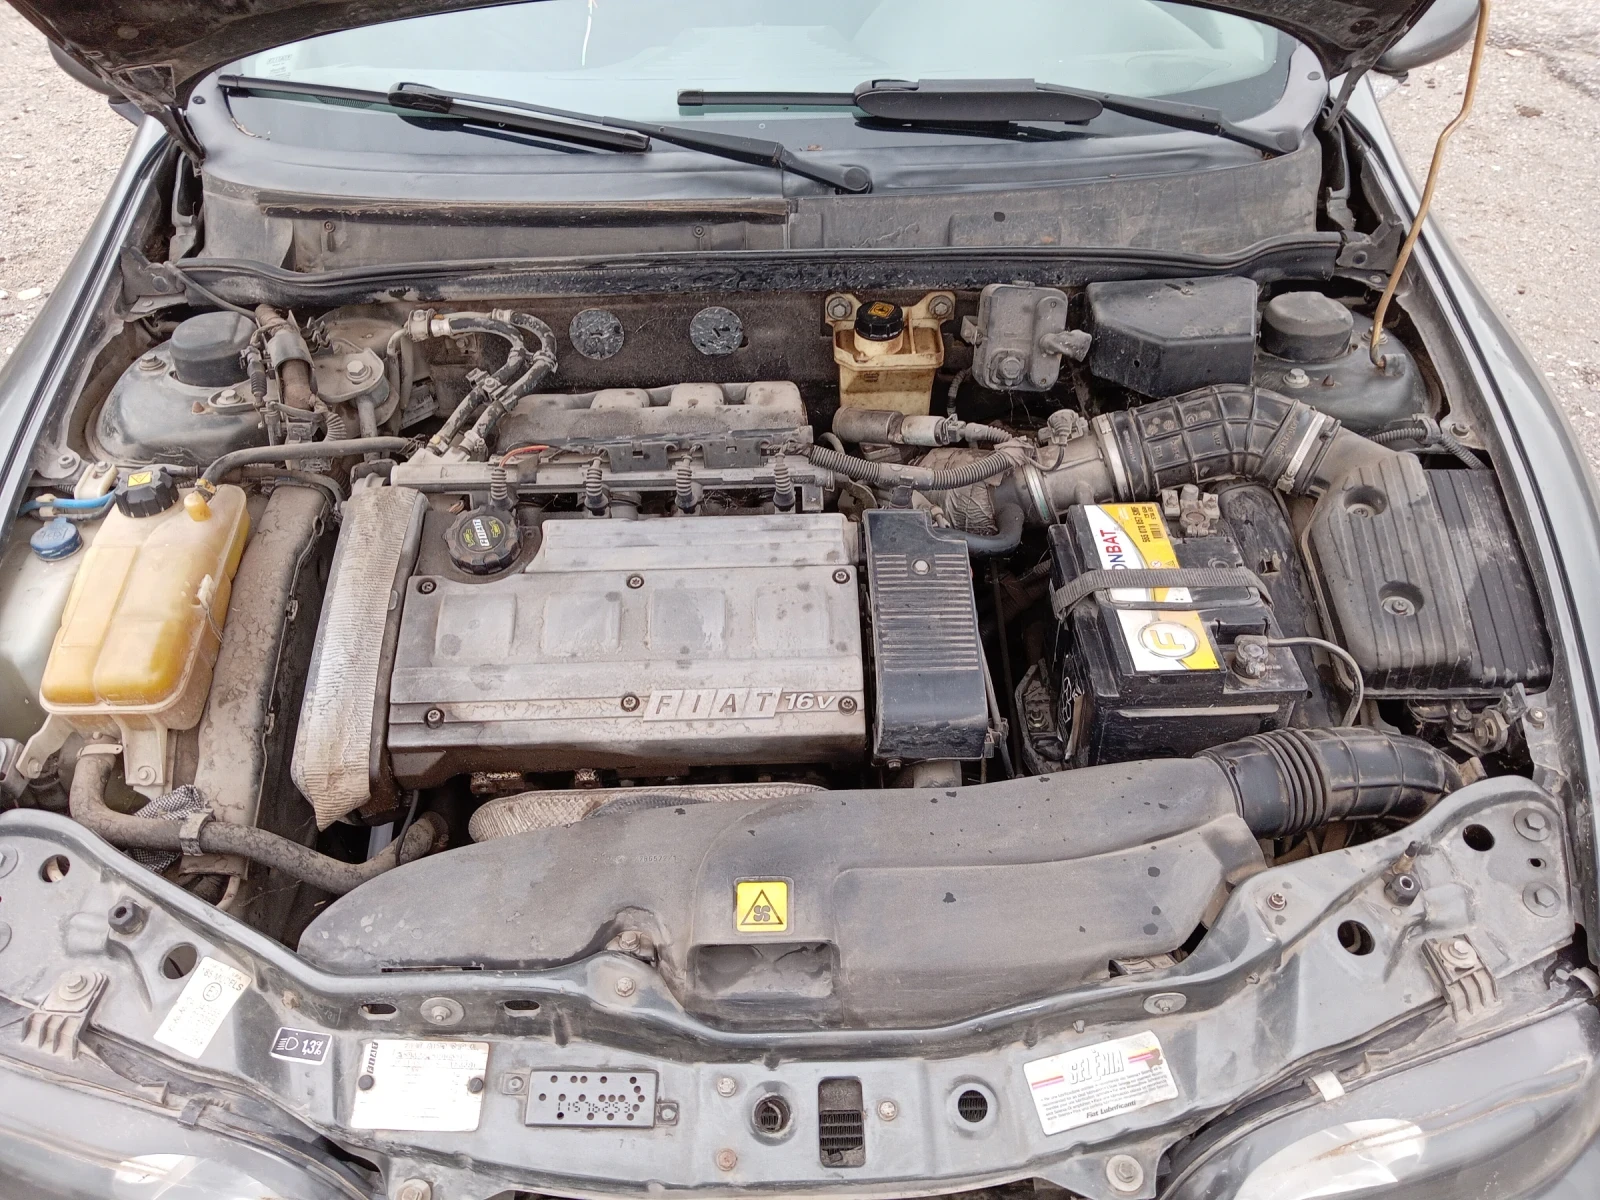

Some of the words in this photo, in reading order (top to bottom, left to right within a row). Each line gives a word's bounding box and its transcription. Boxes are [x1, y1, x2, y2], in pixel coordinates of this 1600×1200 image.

[472, 518, 490, 547] FIAT
[653, 691, 775, 716] FIAT
[366, 1041, 379, 1075] FIAT
[1086, 1110, 1099, 1119] Fiat
[1100, 1099, 1136, 1115] Lubrificanti
